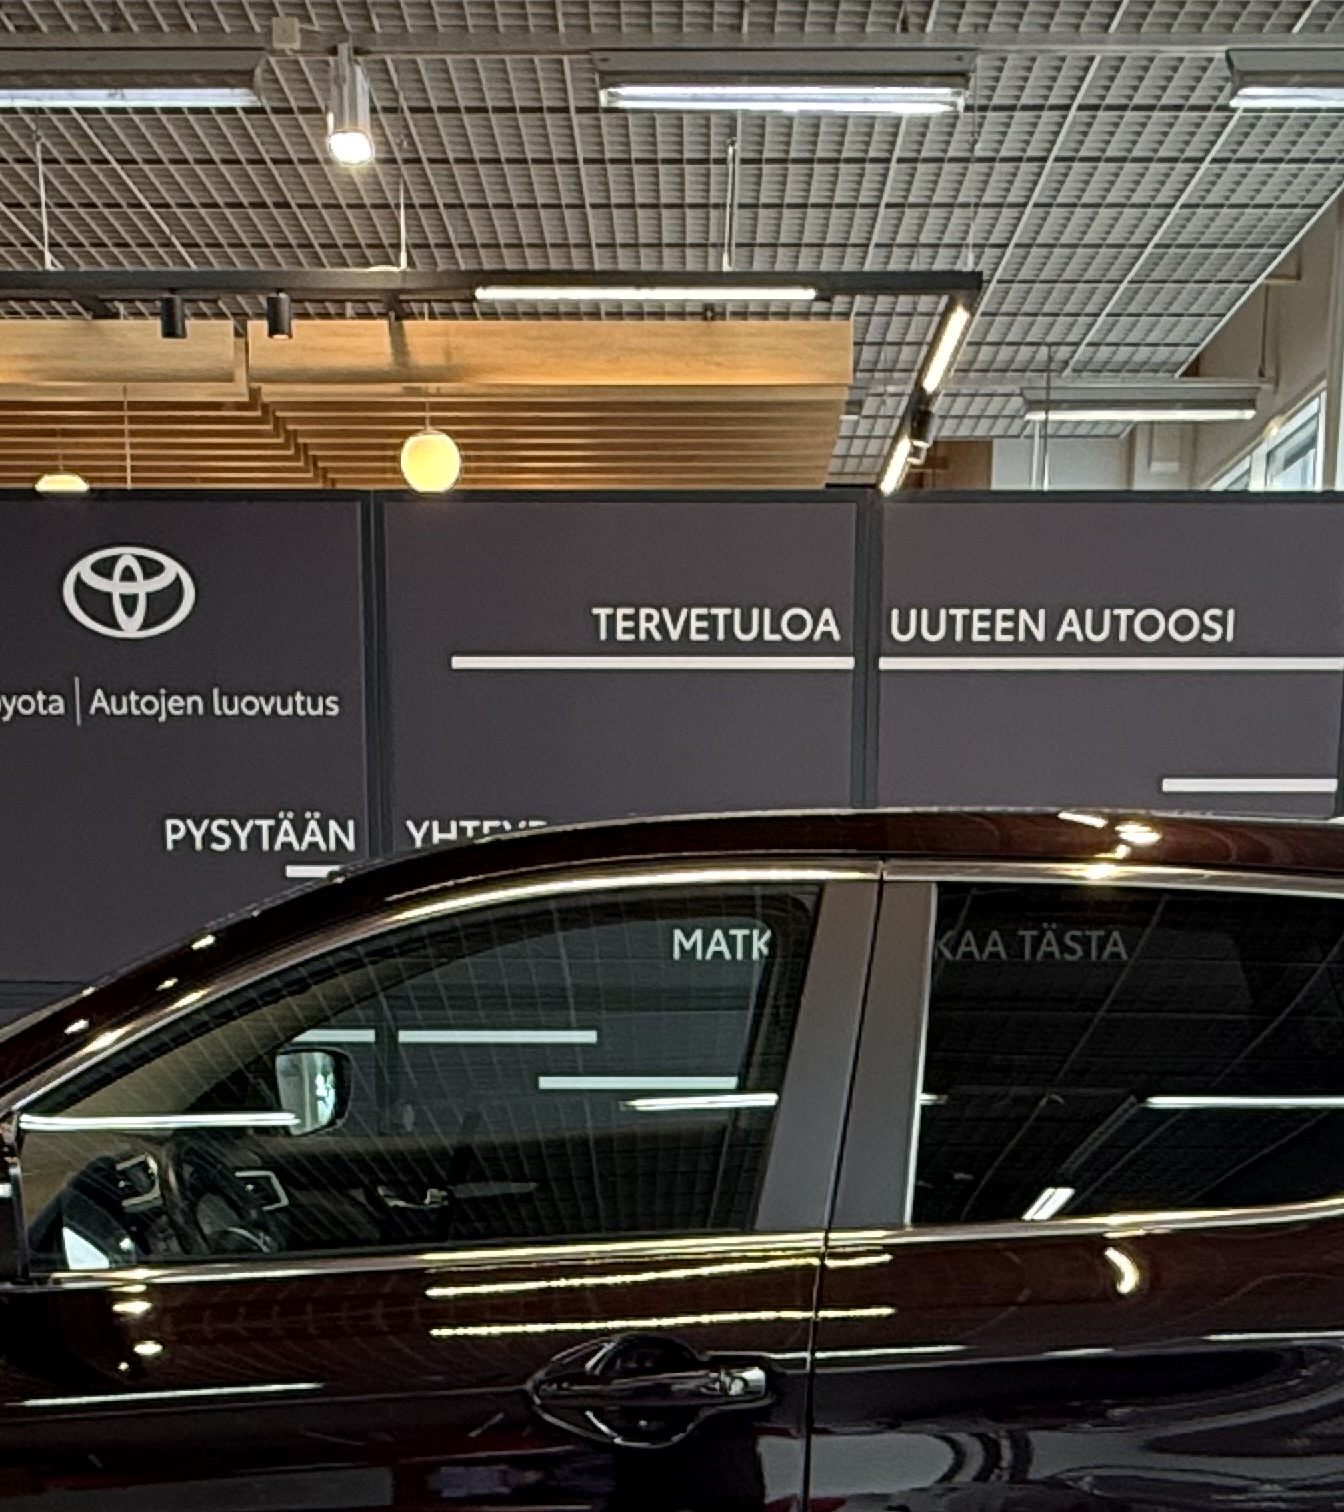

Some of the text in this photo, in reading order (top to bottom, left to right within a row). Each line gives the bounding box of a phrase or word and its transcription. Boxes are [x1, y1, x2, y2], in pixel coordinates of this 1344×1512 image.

[591, 607, 1235, 642] TERVETULOA UUTEEN AUTOOSI
[89, 687, 204, 722] Autojen
[212, 687, 340, 716] luovutus
[165, 810, 356, 852] PYSYTÄÄN
